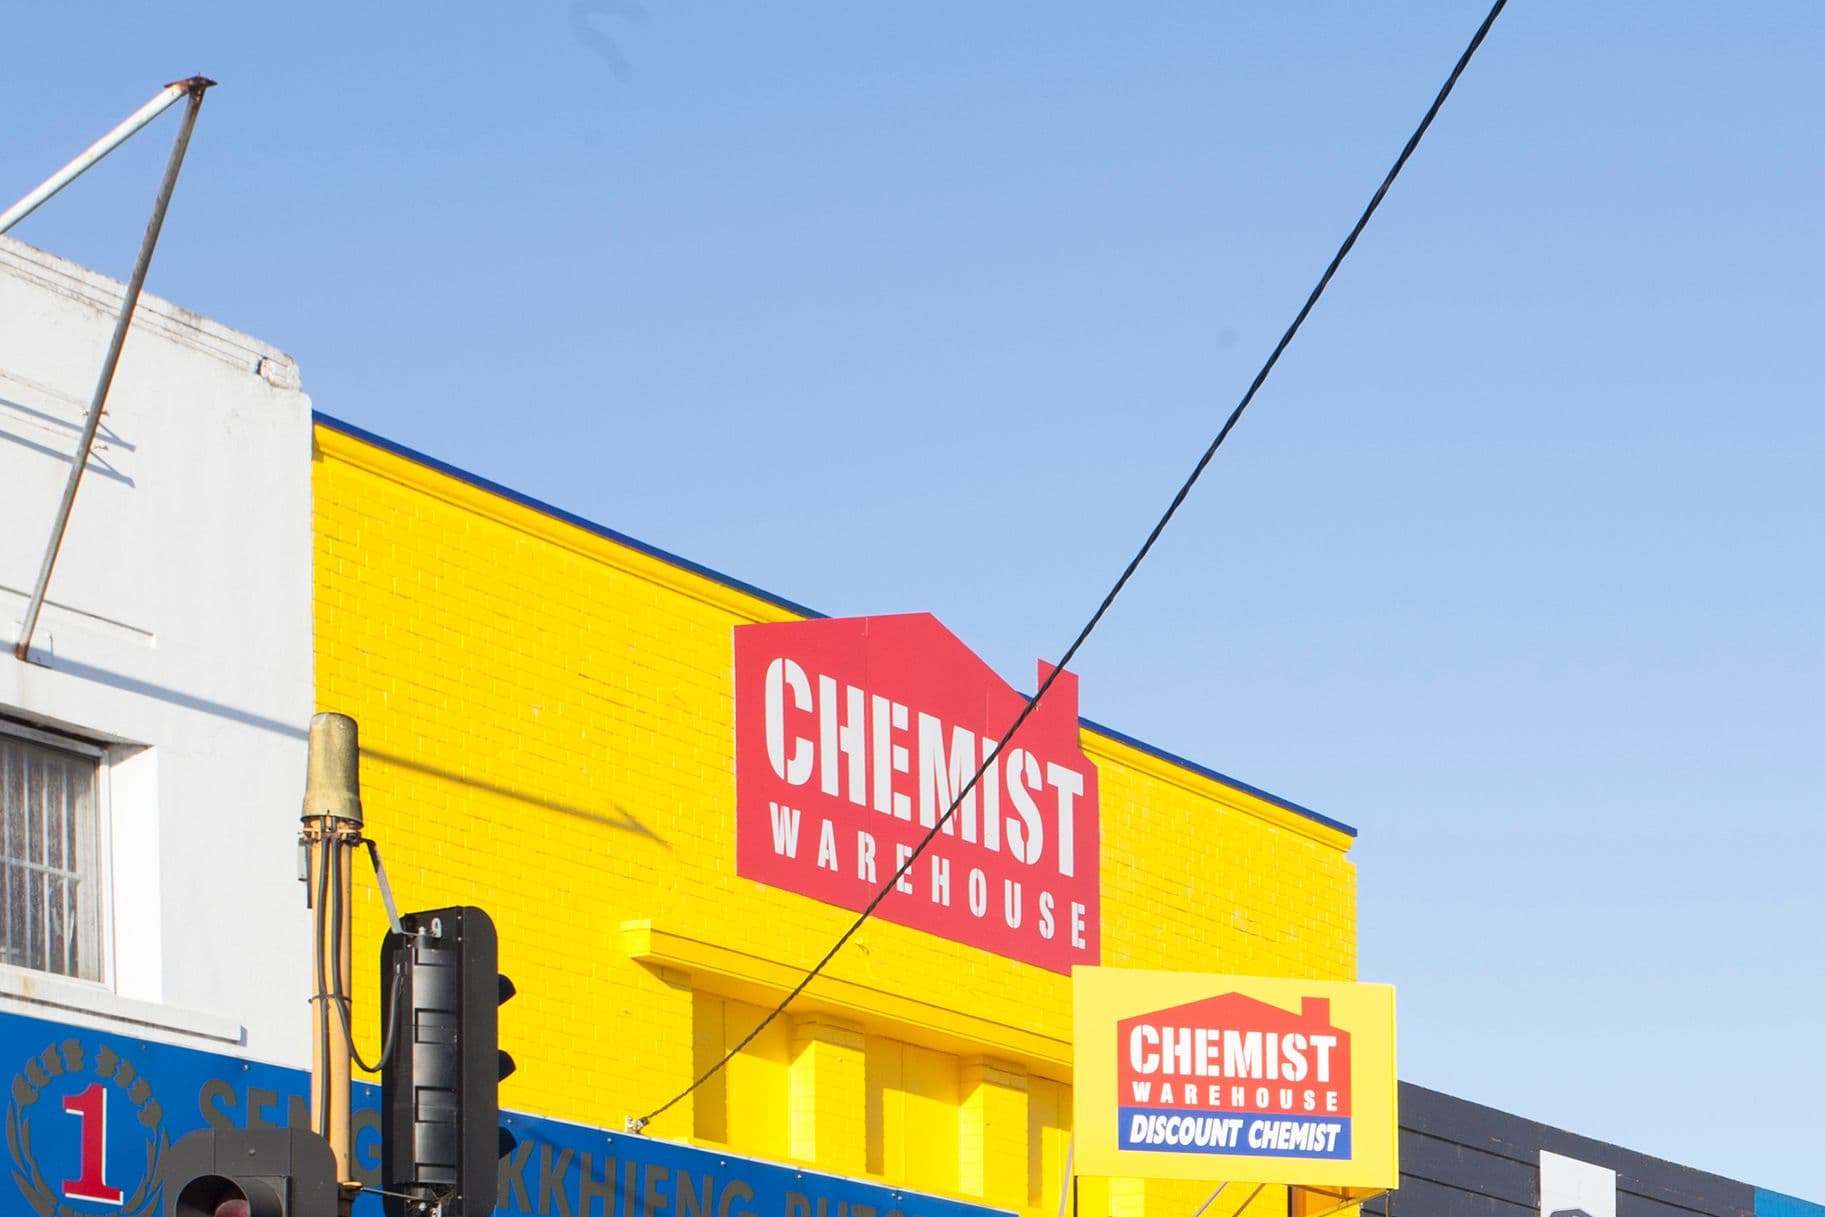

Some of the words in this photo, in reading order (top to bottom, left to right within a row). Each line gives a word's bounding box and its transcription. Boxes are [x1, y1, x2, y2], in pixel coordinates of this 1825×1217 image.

[764, 657, 1084, 878] CHEMIST
[769, 801, 1086, 950] WAREHOUSE
[1129, 1024, 1337, 1083] CHEMIST
[1132, 1081, 1338, 1112] WAREHOUSE
[1129, 1114, 1243, 1148] DISCOUNT
[1247, 1121, 1341, 1152] CHEMIST
